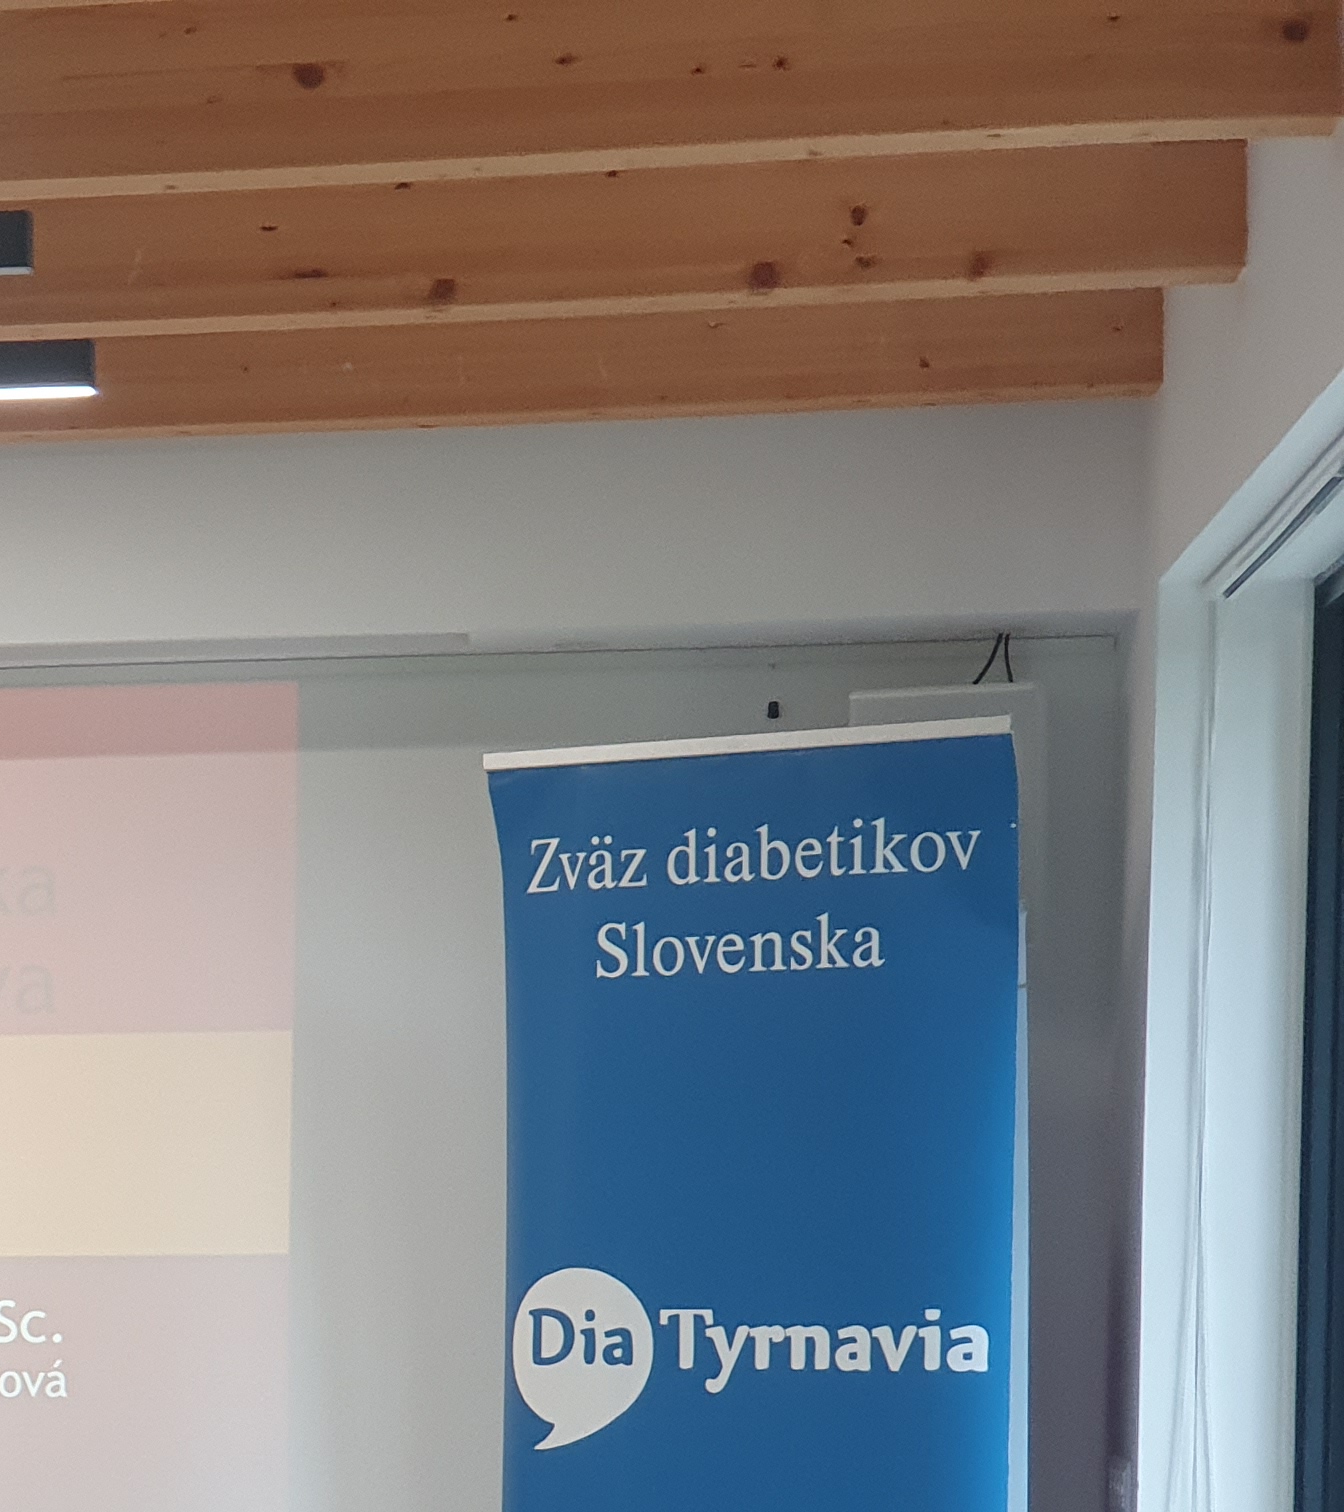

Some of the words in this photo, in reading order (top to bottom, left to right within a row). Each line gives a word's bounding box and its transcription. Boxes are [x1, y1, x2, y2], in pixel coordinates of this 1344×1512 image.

[527, 835, 647, 894] Zväz
[667, 817, 981, 886] diabetikov
[596, 913, 885, 979] Slovenska
[528, 1308, 634, 1366] Dia
[659, 1308, 990, 1394] Tyrnavia
